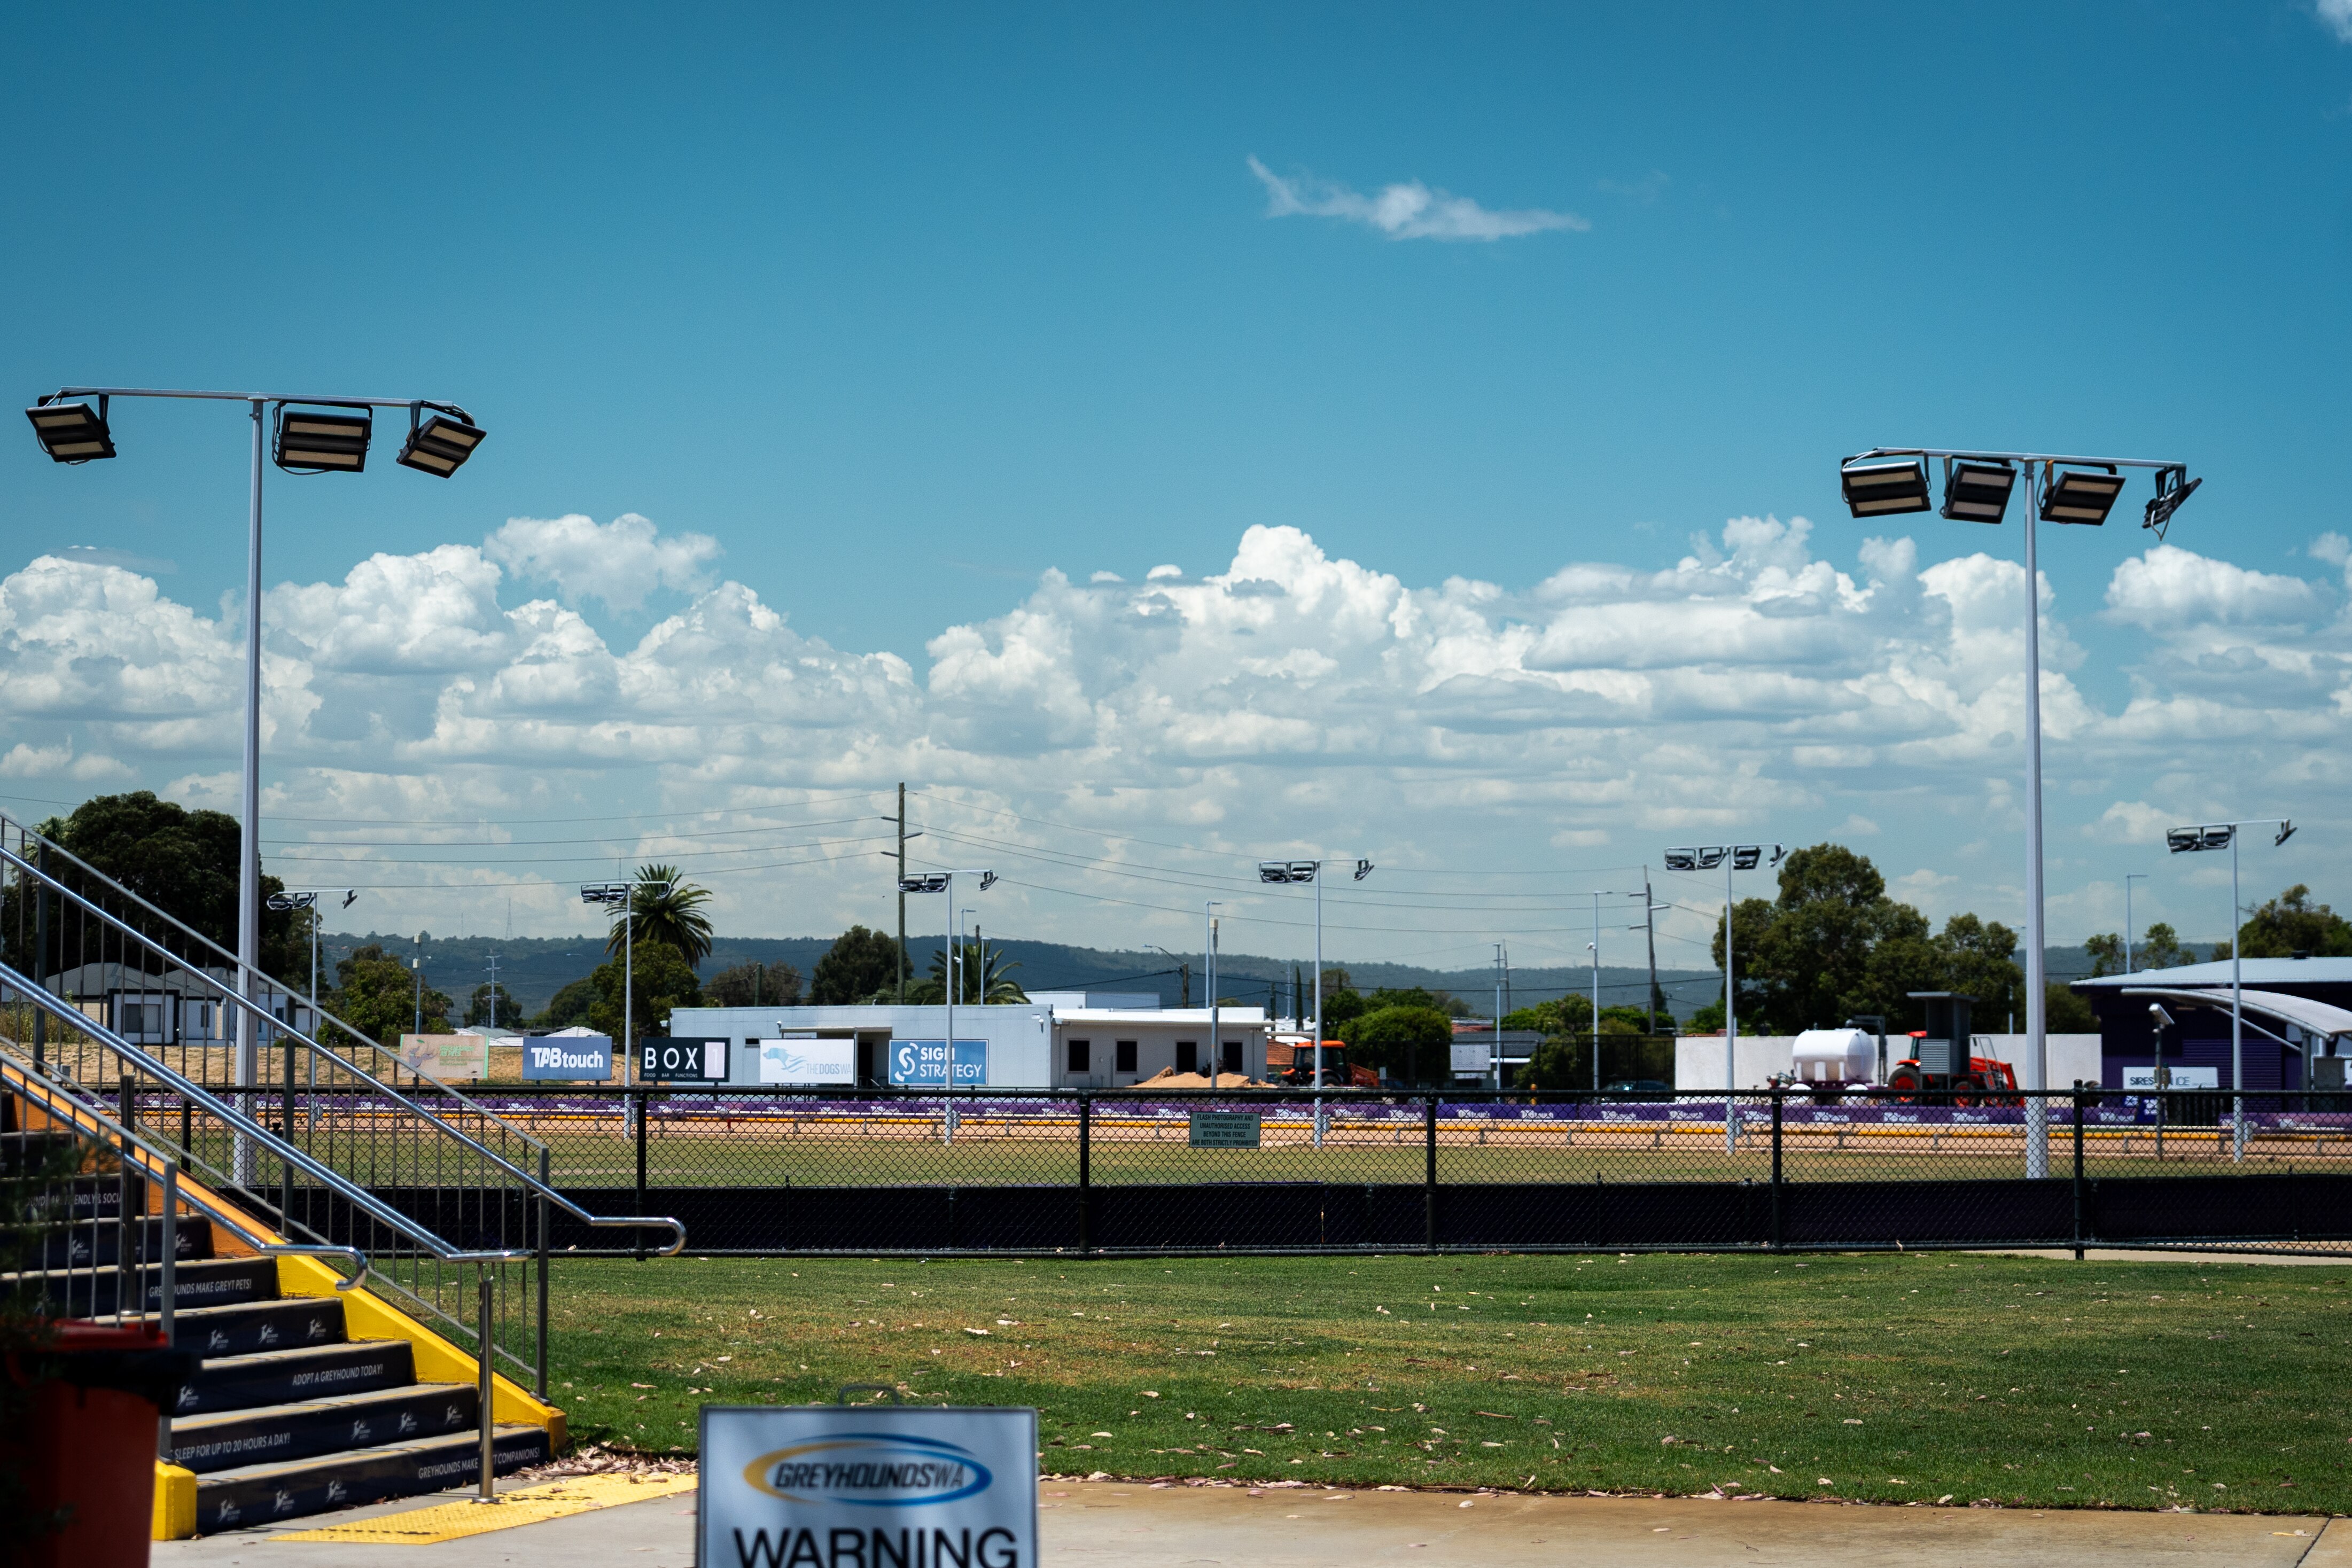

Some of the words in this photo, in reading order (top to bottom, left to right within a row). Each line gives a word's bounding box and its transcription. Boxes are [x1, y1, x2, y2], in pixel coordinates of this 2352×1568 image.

[531, 1047, 604, 1068] TABtouch
[644, 1047, 698, 1070] BOX
[920, 1064, 982, 1078] STRATEGY
[149, 1283, 194, 1297] GREUNDS
[196, 1282, 213, 1293] MAKE
[215, 1280, 235, 1292] GREYT
[236, 1278, 252, 1290] PETS!
[292, 1372, 314, 1385] ADOPT
[314, 1372, 320, 1383] A
[321, 1367, 360, 1382] GREYHOUND
[361, 1363, 383, 1377] TODAY!
[175, 1446, 195, 1460] SLEEP
[196, 1445, 210, 1457] FOR
[212, 1443, 221, 1455] UP
[223, 1441, 232, 1453] TO
[233, 1440, 241, 1452] 20
[243, 1436, 267, 1450] HOURS
[268, 1435, 273, 1447] A
[274, 1433, 290, 1445] DAY!
[418, 1461, 461, 1479] GREYHOUNDS
[462, 1458, 478, 1471] MAKE
[497, 1447, 540, 1464] COMPANIONS!
[734, 1527, 1017, 1568] WARNING
